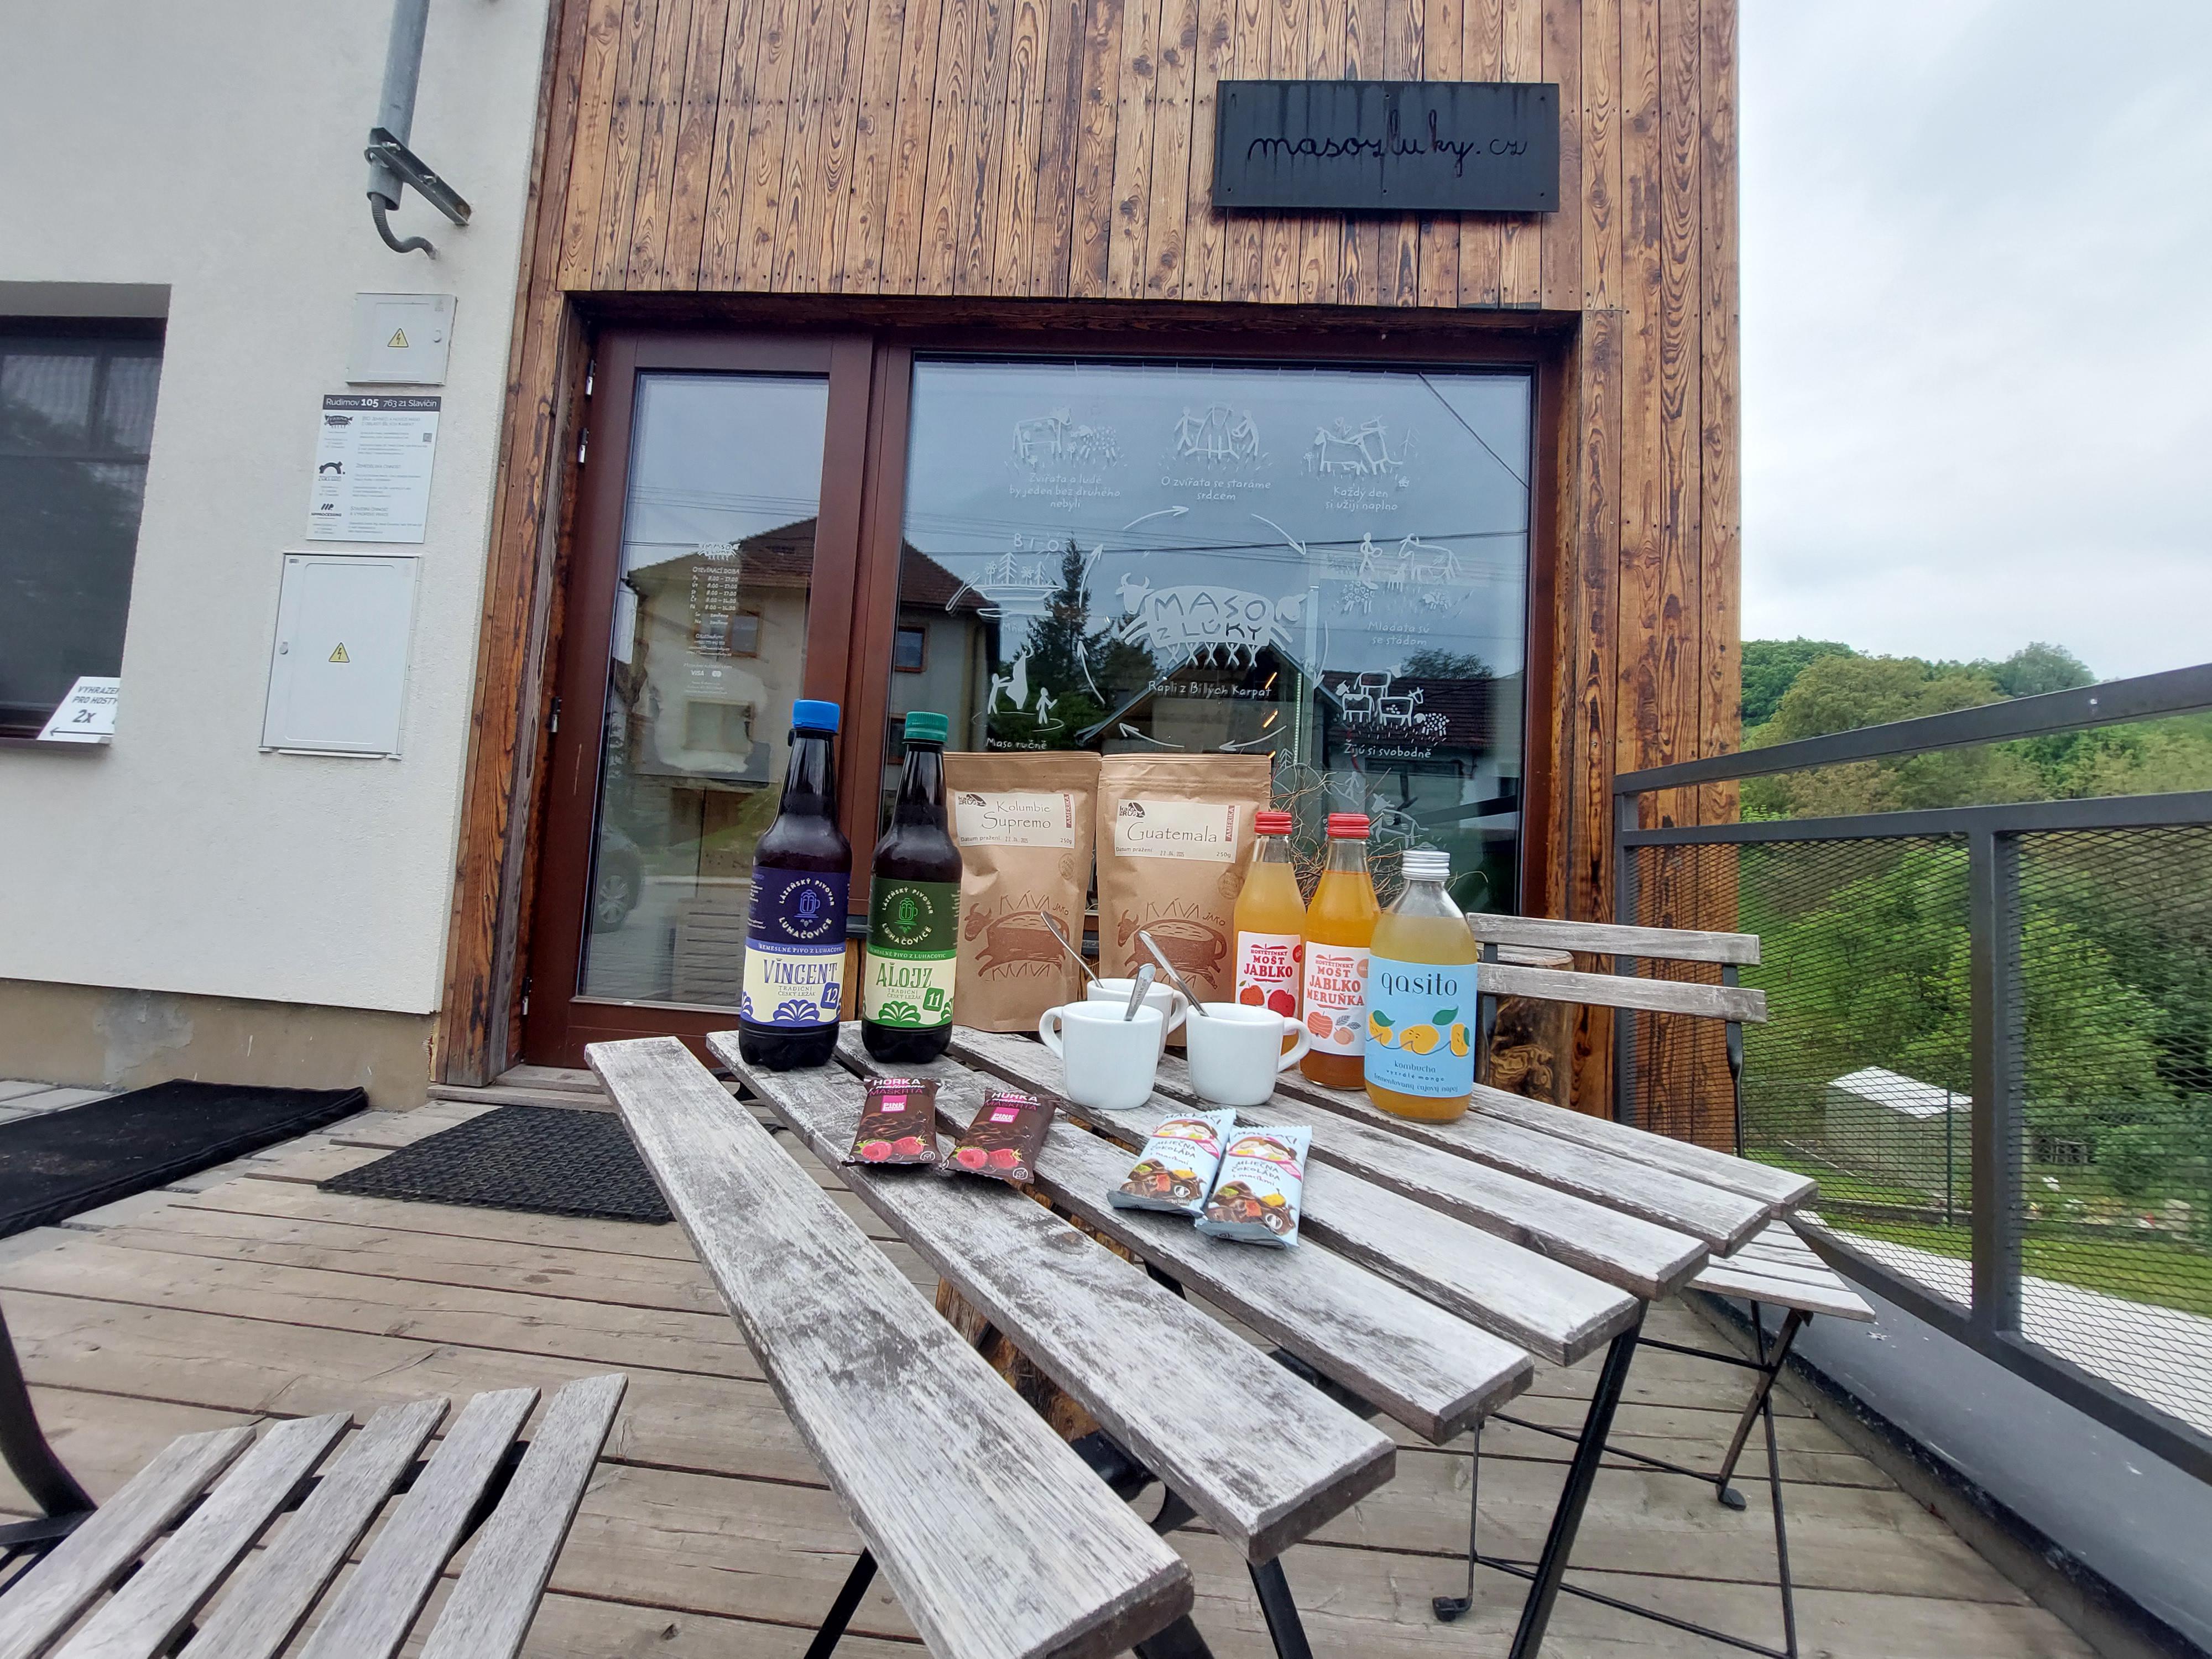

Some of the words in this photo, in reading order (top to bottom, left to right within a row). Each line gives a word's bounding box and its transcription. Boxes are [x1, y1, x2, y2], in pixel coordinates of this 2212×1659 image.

[326, 398, 359, 406] Rudimov
[361, 398, 379, 408] 105
[1029, 472, 1067, 483] Zvířata
[1161, 476, 1170, 486] O
[1173, 477, 1211, 487] zvířata
[1227, 479, 1271, 489] staráme
[1009, 484, 1021, 498] by
[1023, 485, 1052, 498] jeden
[1056, 484, 1073, 496] bez
[1076, 486, 1121, 497] druhého
[1197, 489, 1236, 500] srdcem
[1334, 486, 1366, 503] Každý
[1369, 487, 1389, 497] den
[1051, 498, 1081, 512] nebyli
[1326, 499, 1333, 509] si
[1362, 500, 1398, 513] naplno
[1154, 591, 1267, 622] MASO
[1181, 619, 1262, 641] LÚKY
[1418, 623, 1430, 634] sú
[1372, 636, 1383, 644] se
[1386, 634, 1427, 646] stádom
[1180, 685, 1187, 693] z
[1232, 684, 1272, 699] Karpat
[986, 737, 1013, 748] Maso
[1015, 739, 1048, 749] ručně
[1368, 745, 1376, 755] si
[1379, 745, 1432, 758] svobodně
[997, 800, 1051, 813] Kolumbie
[1063, 795, 1072, 825] AMERIKA
[981, 811, 1051, 834] Supremo
[1226, 806, 1235, 838] AMERIKA
[1127, 822, 1217, 842] Guatemala
[779, 878, 811, 904] LÁZEŇSKÝ
[815, 880, 834, 906] PIVOVAR
[881, 886, 909, 911] LÁZEŇSKÝ
[912, 888, 934, 914] PIVOVAR
[999, 890, 1050, 915] KÁVA
[1052, 902, 1069, 916] JAKO
[1146, 898, 1199, 922] KÁVA
[778, 917, 832, 939] LUHAČOVICE
[881, 922, 933, 945] LUHAČOVICE
[1253, 955, 1285, 965] MOŠT
[875, 962, 933, 989] ALOJZ
[1243, 963, 1293, 978] JABLKO
[1317, 966, 1351, 978] MOŠT
[1309, 974, 1361, 993] JABLKO
[1381, 972, 1458, 997] qasito
[824, 987, 838, 1004] 12
[926, 992, 941, 1008] 11
[1307, 988, 1365, 1006] MERUŇKA
[1386, 1070, 1415, 1079] vyzrálé
[1394, 1060, 1437, 1073] kombucha
